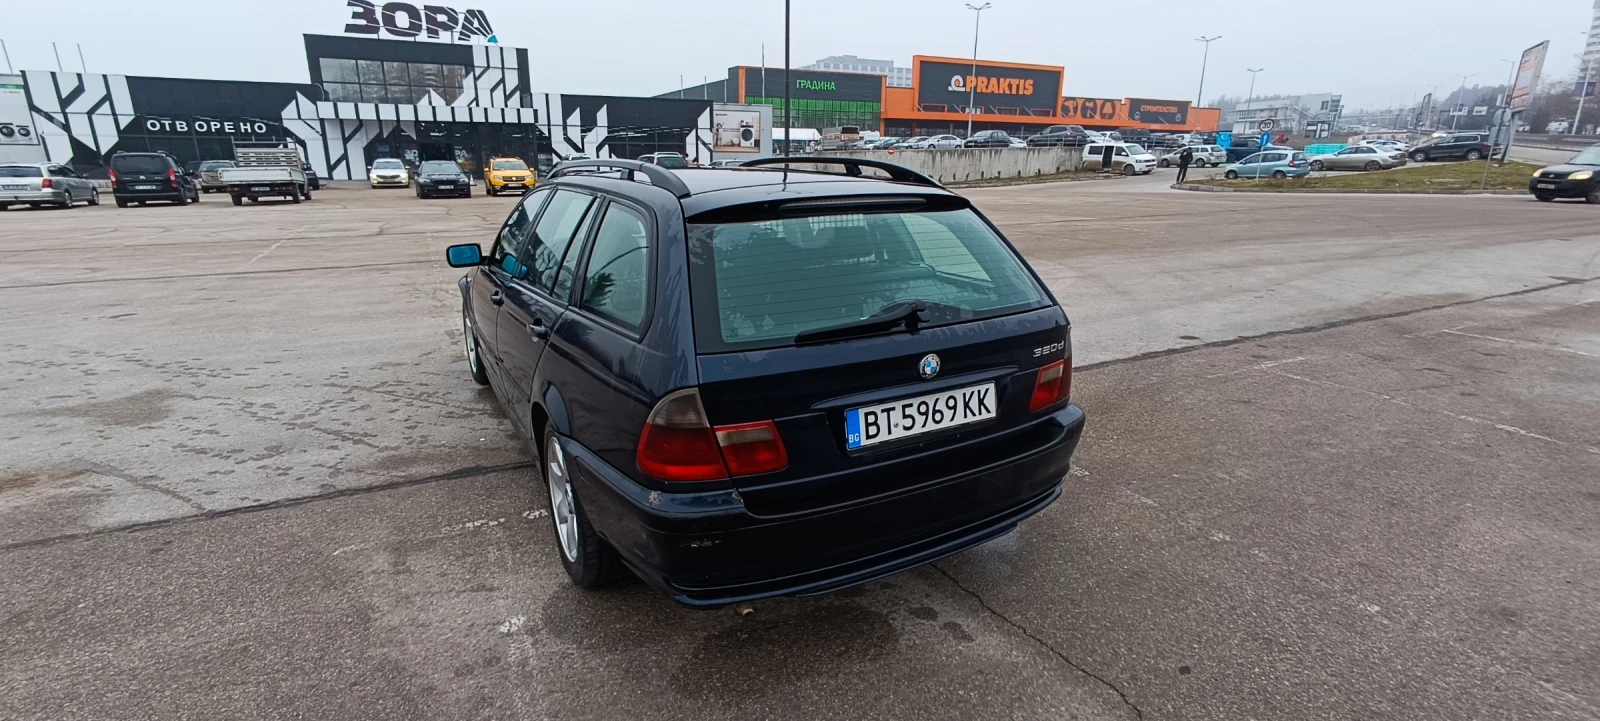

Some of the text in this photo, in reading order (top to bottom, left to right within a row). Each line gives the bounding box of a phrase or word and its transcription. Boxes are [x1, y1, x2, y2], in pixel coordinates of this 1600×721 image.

[344, 0, 496, 41] ЗОРА
[796, 79, 836, 91] ГРАДИНА
[965, 75, 1034, 95] PRAKTIS
[1140, 105, 1179, 113] СТРОИТЕЛСТВО
[146, 119, 267, 133] ОТВОРЕНО
[1262, 121, 1272, 129] 30
[1032, 340, 1065, 358] 320d
[863, 387, 992, 441] BT 5969 KK
[848, 432, 861, 444] BG
